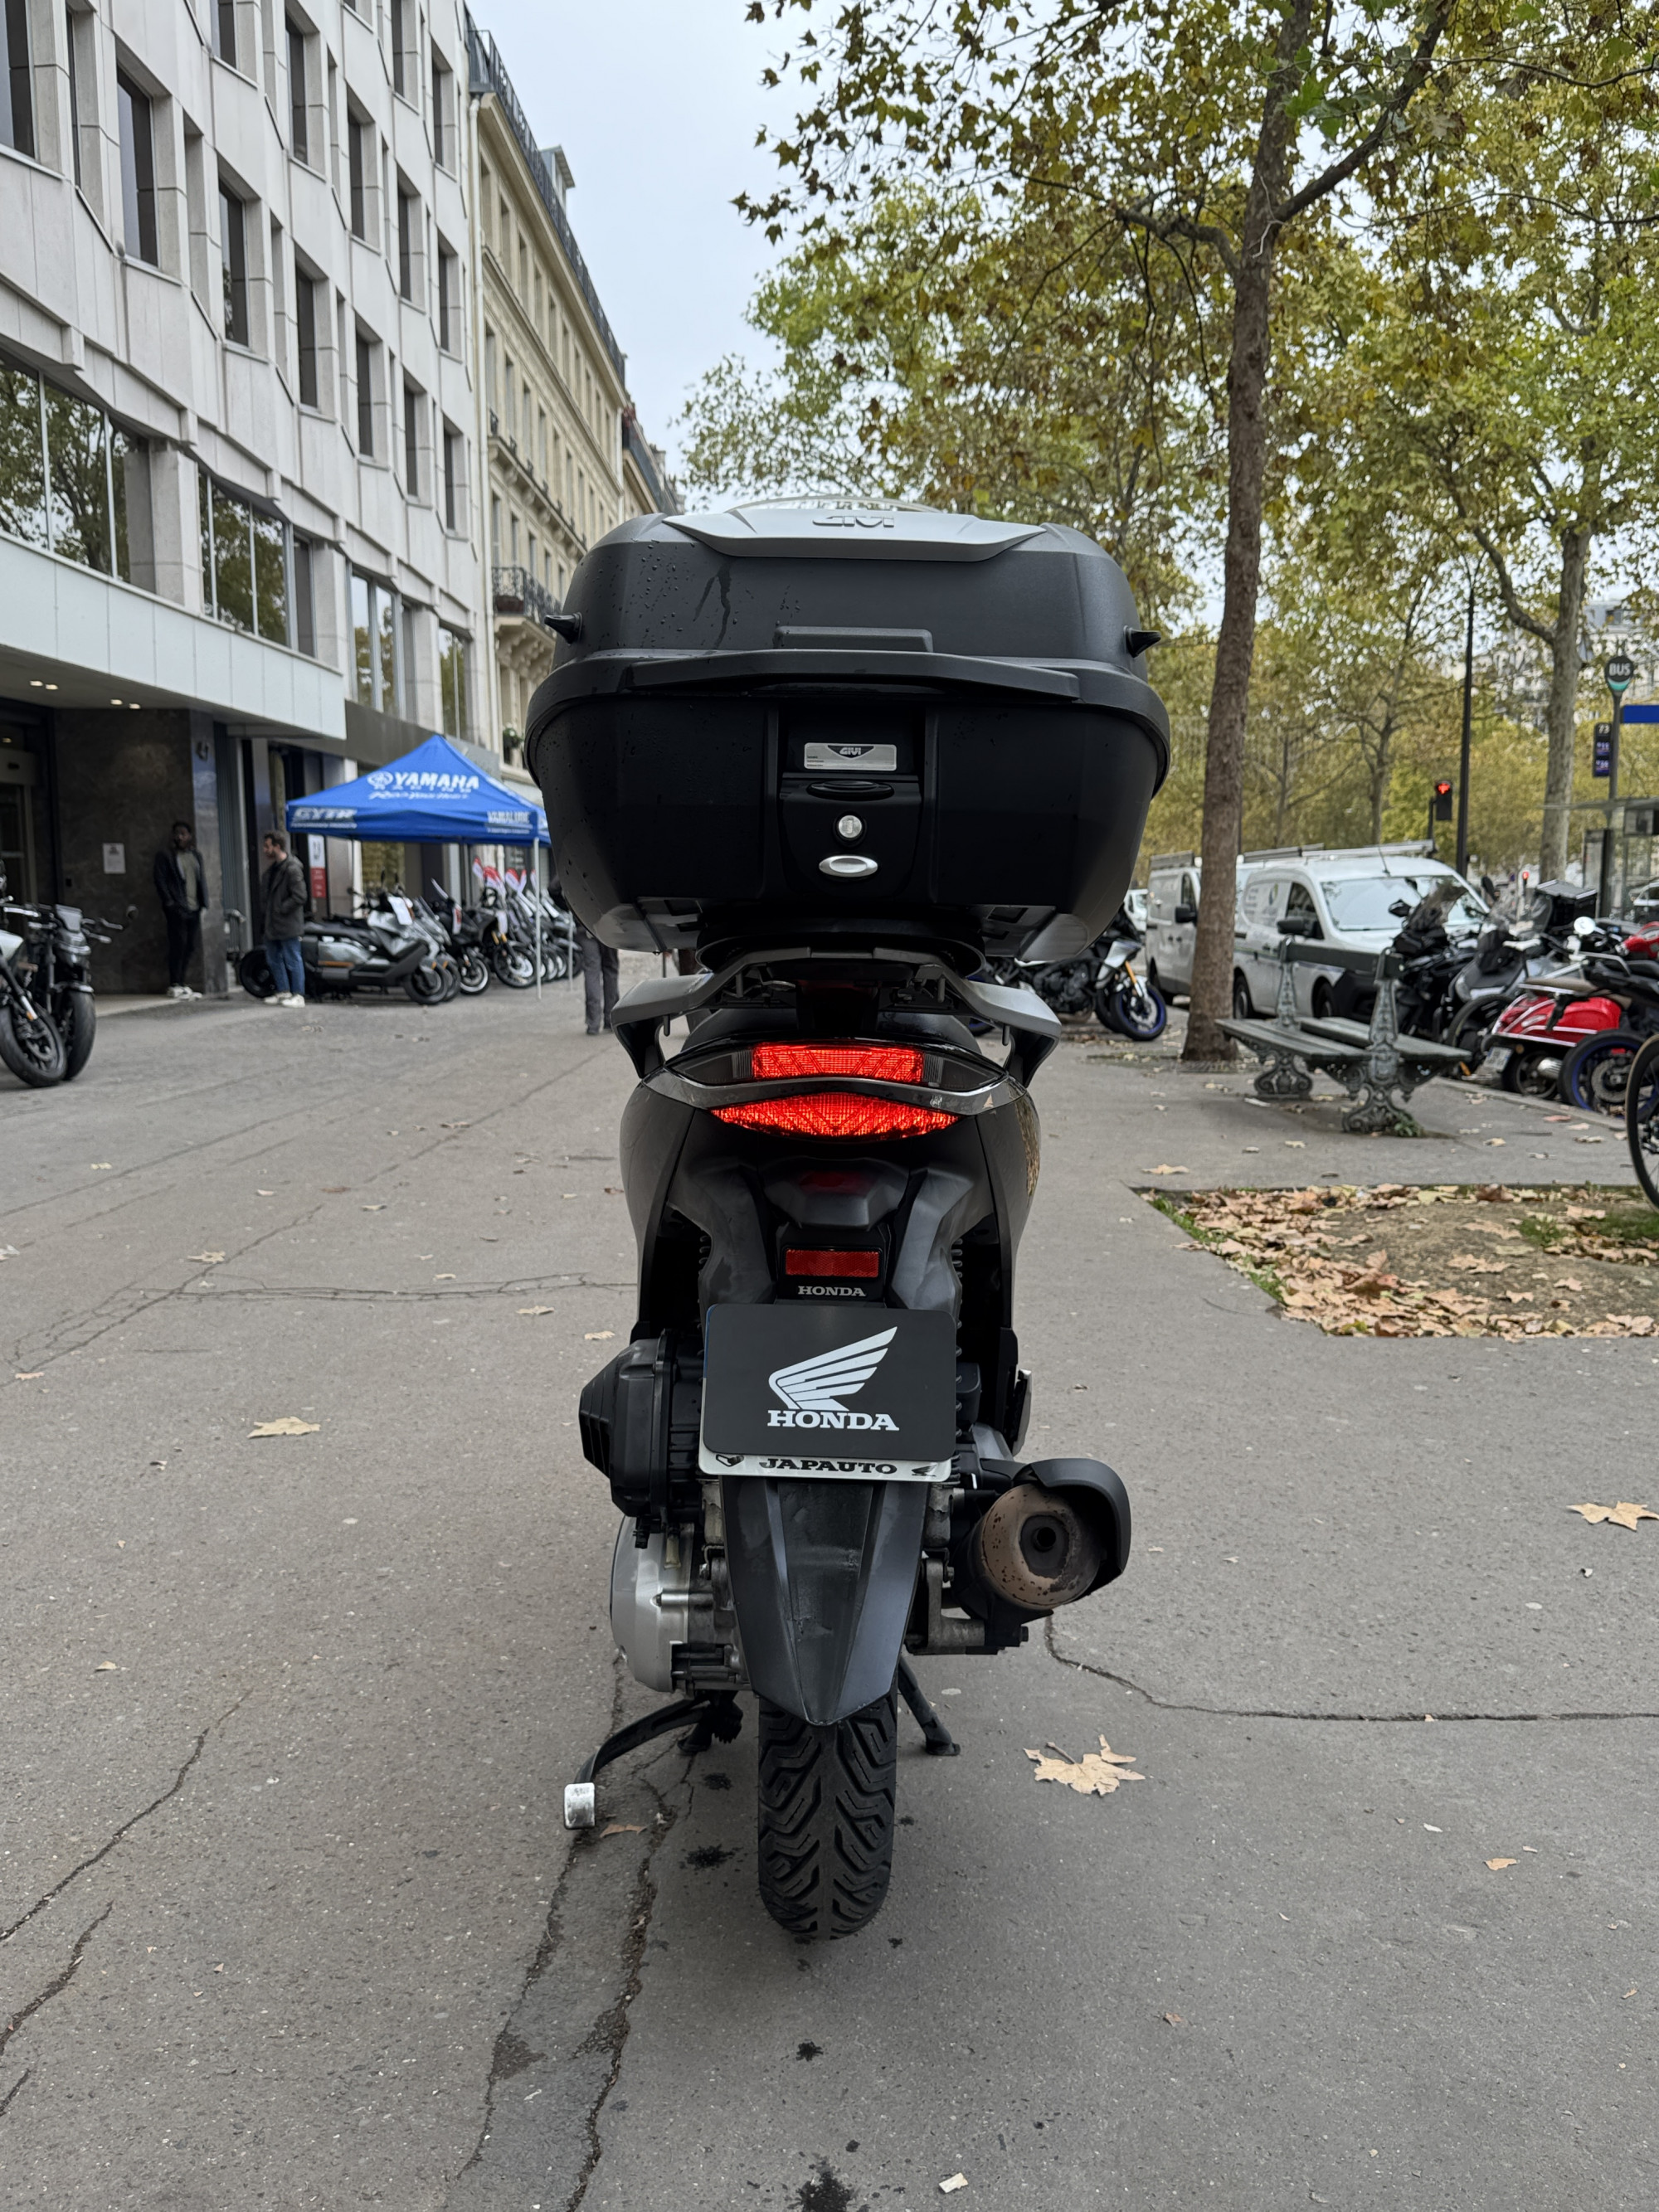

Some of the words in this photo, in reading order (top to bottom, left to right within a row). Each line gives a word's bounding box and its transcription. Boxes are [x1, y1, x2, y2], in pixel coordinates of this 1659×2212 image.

[1609, 663, 1631, 677] BUS
[839, 746, 862, 756] GIVI
[394, 771, 479, 790] YAMAHA
[797, 1285, 866, 1297] HONDA
[766, 1408, 900, 1432] HONDA
[758, 1457, 898, 1475] JAPAUTO
